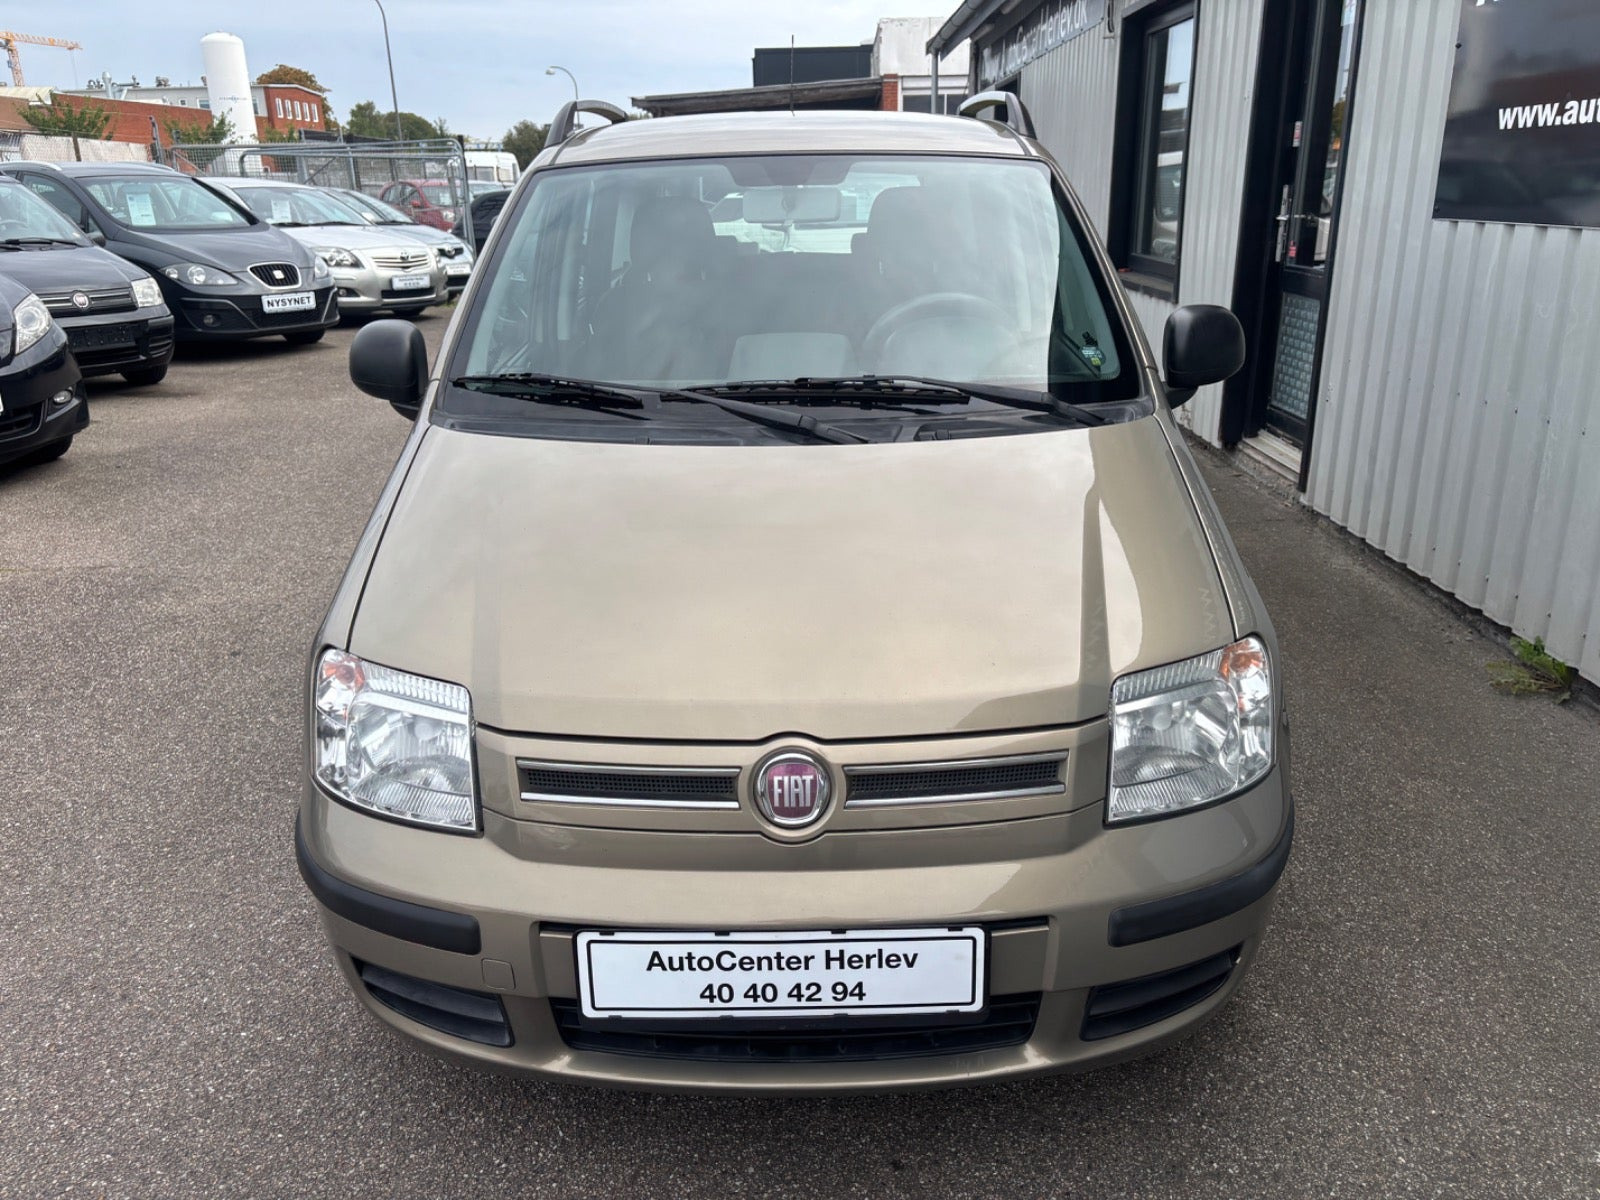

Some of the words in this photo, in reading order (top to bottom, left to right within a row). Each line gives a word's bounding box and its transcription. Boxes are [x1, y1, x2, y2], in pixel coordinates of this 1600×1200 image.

[267, 296, 311, 308] NYSYNET
[773, 775, 814, 807] FIAT
[647, 950, 816, 971] AutoCenter
[825, 949, 918, 969] Herlev
[700, 983, 735, 1003] 40
[743, 983, 778, 1003] 40
[788, 982, 823, 1003] 42
[831, 981, 866, 1002] 94
